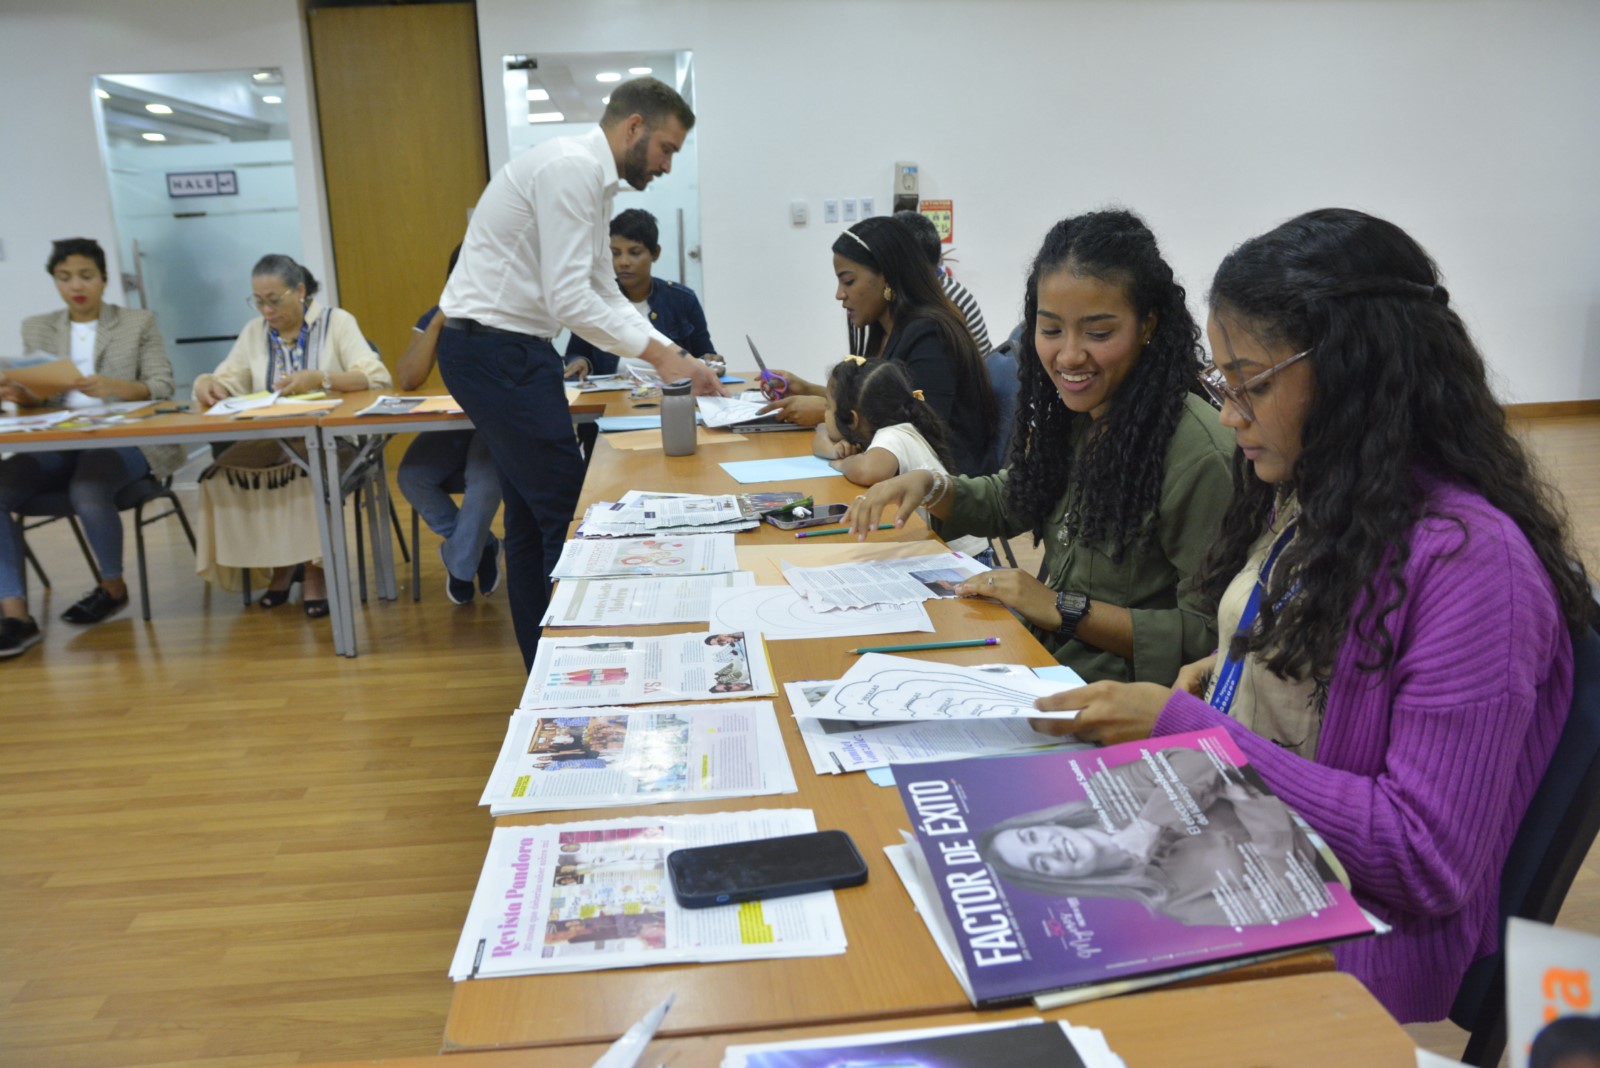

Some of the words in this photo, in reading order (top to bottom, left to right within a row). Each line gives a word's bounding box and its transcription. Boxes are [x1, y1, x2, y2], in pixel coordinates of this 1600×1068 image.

[643, 681, 662, 694] VS
[1066, 759, 1087, 781] Santos
[1139, 748, 1178, 801] transformador
[1154, 752, 1180, 783] femenino
[907, 779, 968, 836] ÉXITO
[1173, 781, 1202, 814] liderazgo
[1171, 800, 1195, 827] efecto
[1192, 813, 1210, 825] del
[1186, 826, 1202, 835] El
[505, 837, 534, 899] Pandora
[939, 839, 982, 866] DE
[491, 902, 523, 957] Revista
[946, 869, 1023, 967] FACTOR
